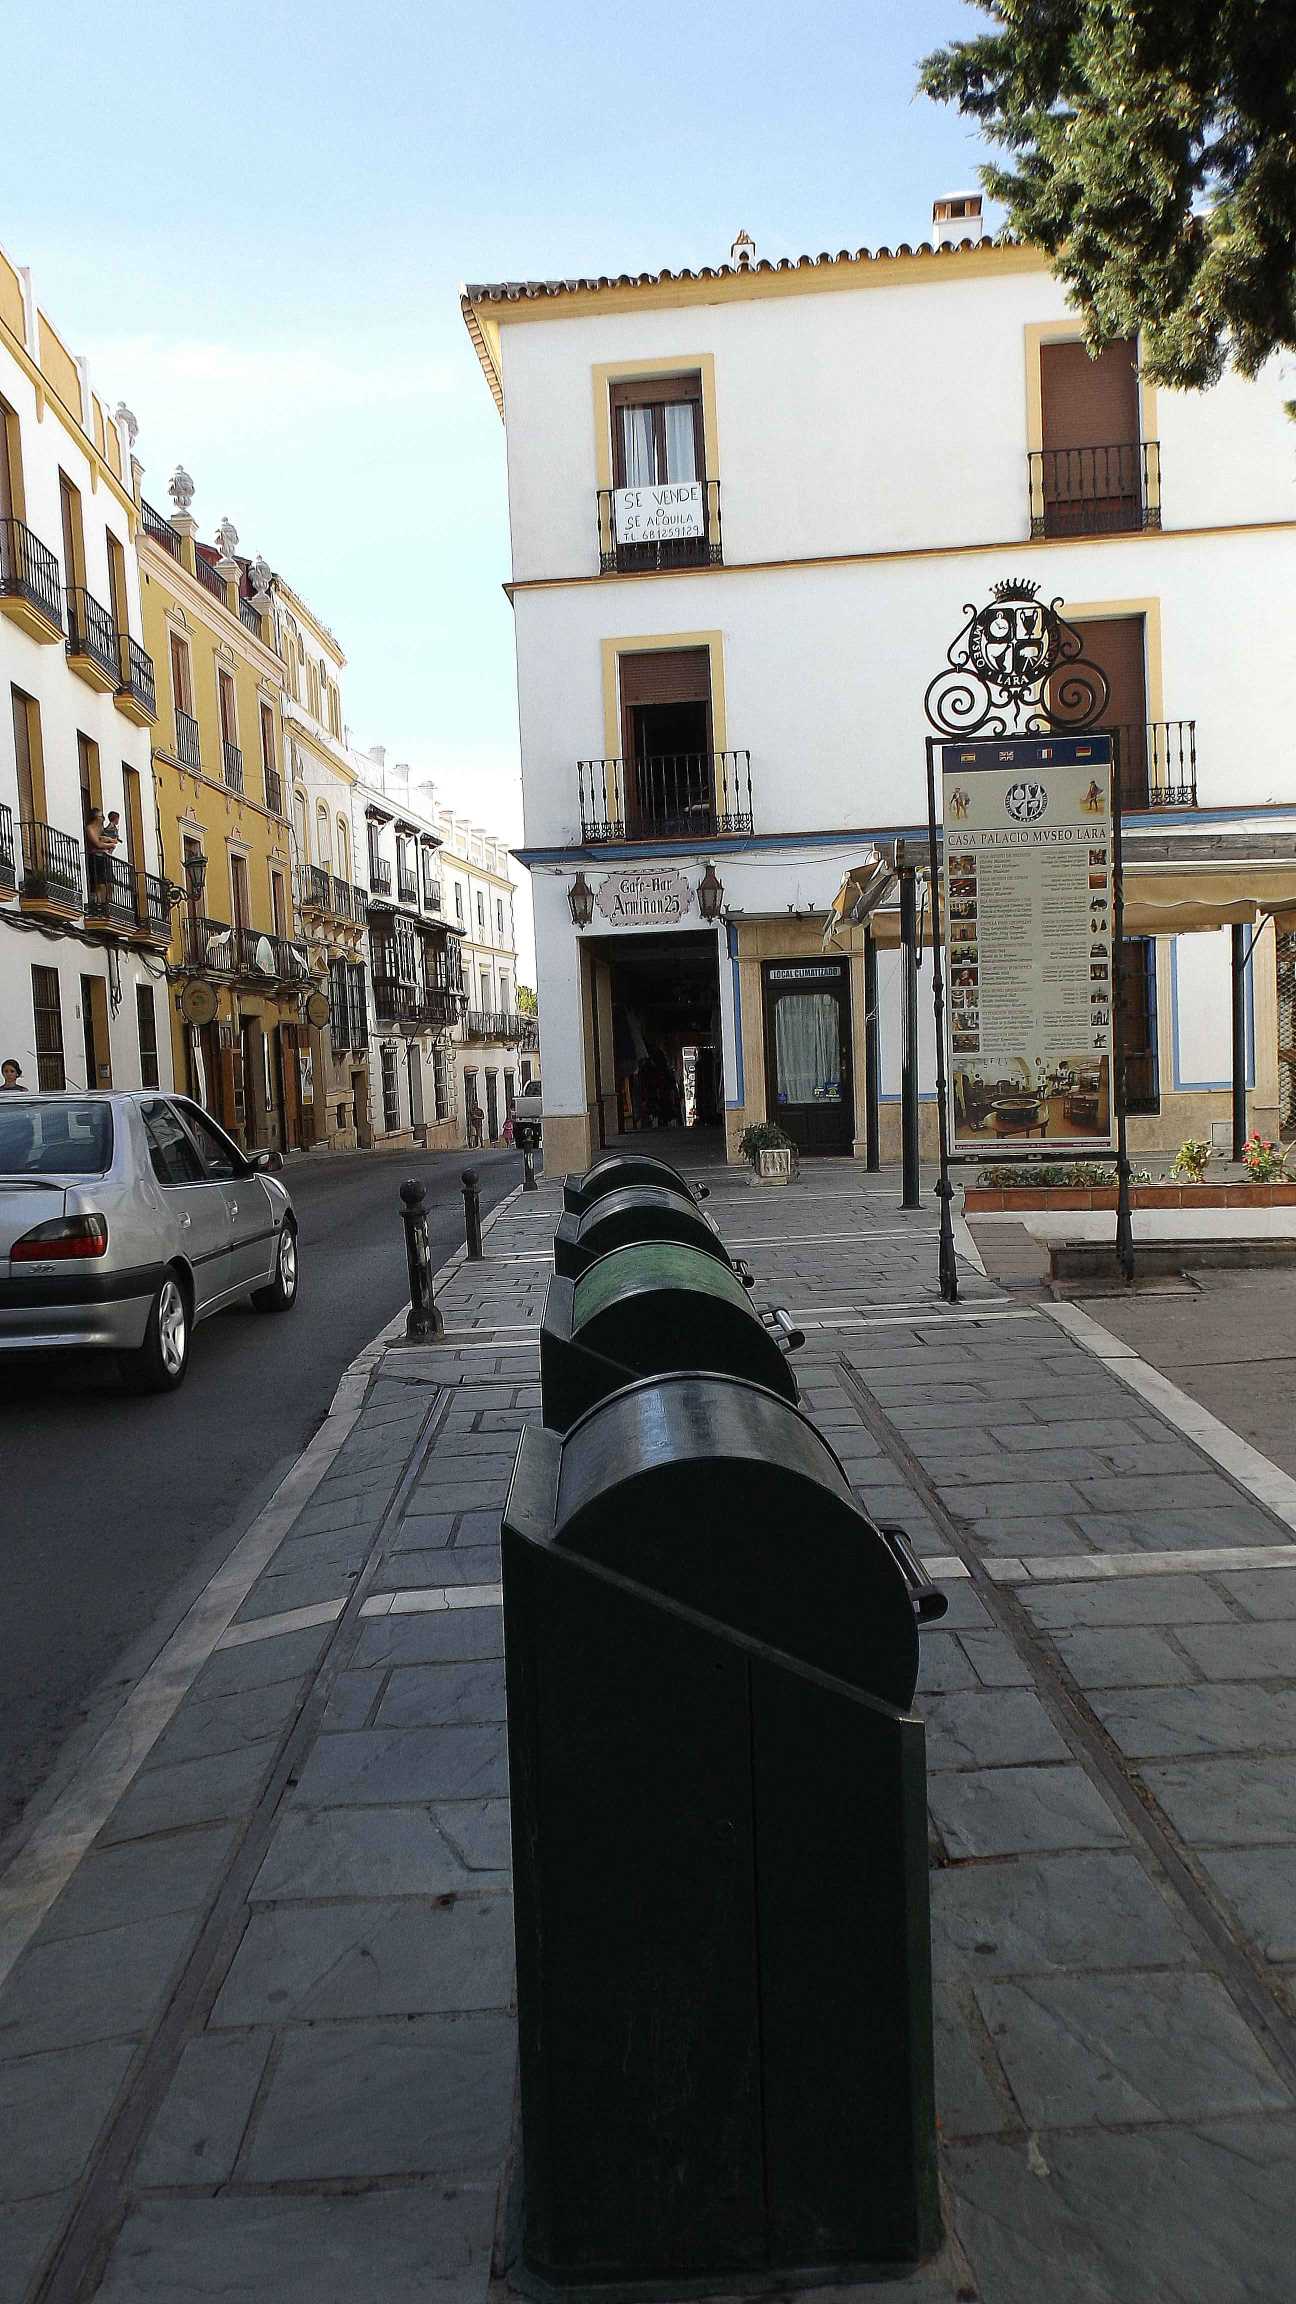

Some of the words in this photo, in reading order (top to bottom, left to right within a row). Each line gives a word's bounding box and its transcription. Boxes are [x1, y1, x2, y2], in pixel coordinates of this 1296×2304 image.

[624, 492, 642, 510] SE
[652, 487, 699, 505] VENDE
[656, 508, 665, 517] O
[625, 515, 641, 531] SE
[647, 513, 694, 527] ALQUILA
[996, 674, 1030, 686] LARA
[948, 834, 976, 846] CASA
[981, 831, 1029, 844] PALACIO
[1033, 829, 1072, 842] MVSEO
[1077, 828, 1106, 840] LARA
[773, 970, 794, 979] LOCAL
[794, 967, 838, 978] CLIMATIZADO
